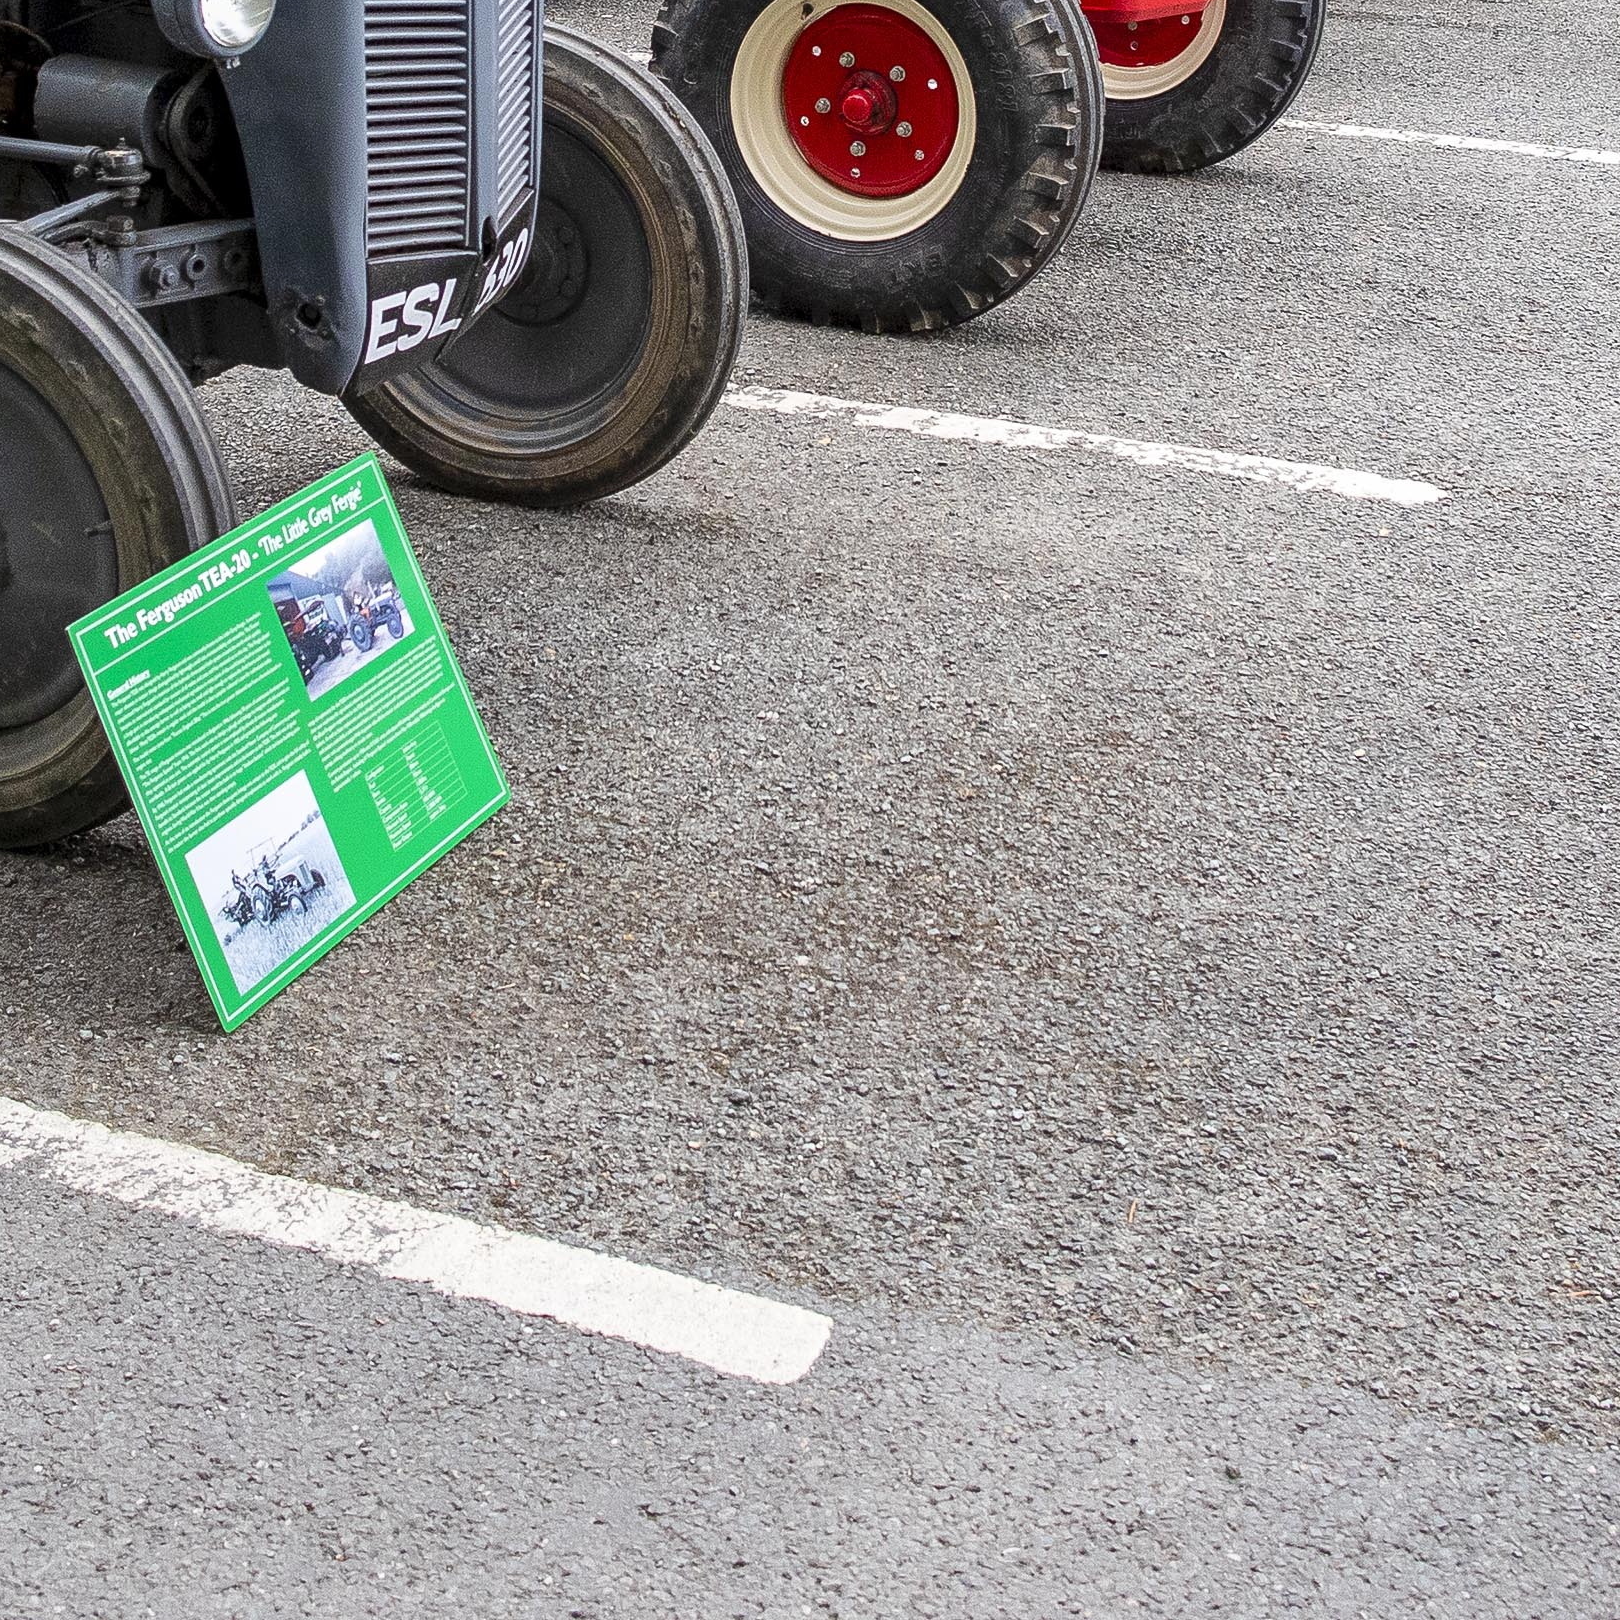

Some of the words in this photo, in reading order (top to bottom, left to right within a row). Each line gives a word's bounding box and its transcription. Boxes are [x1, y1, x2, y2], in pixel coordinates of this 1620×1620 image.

[365, 278, 463, 364] ESL
[104, 621, 138, 648] The
[135, 580, 203, 632] Ferguson
[197, 548, 253, 593] TEA-20
[281, 516, 310, 544] Little
[307, 499, 334, 524] Grey
